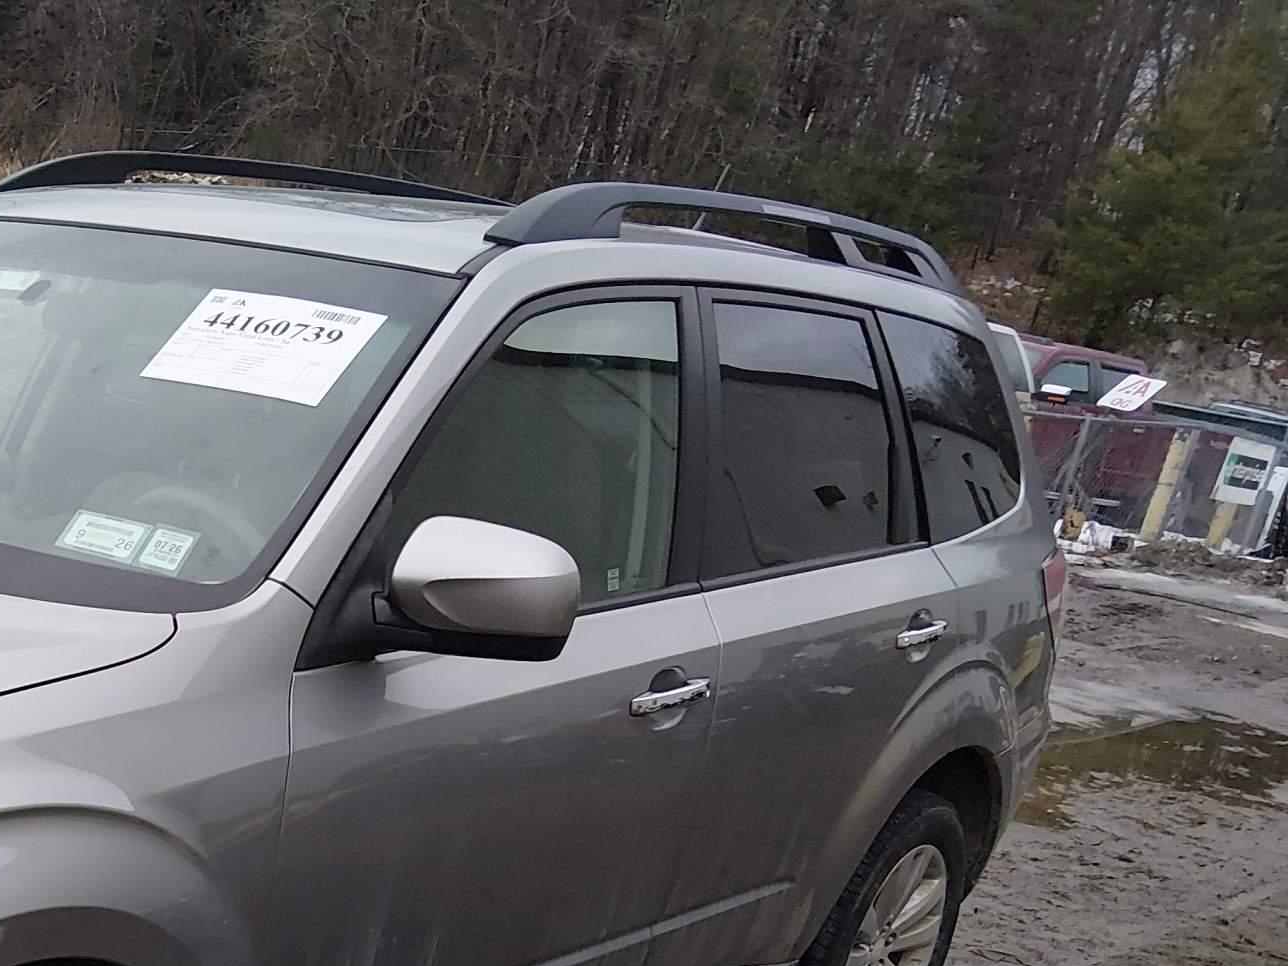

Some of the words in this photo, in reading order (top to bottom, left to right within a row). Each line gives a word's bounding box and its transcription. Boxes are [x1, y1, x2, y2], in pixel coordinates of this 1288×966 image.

[203, 311, 344, 345] 44160739
[114, 538, 135, 551] 26
[167, 543, 183, 554] 26
